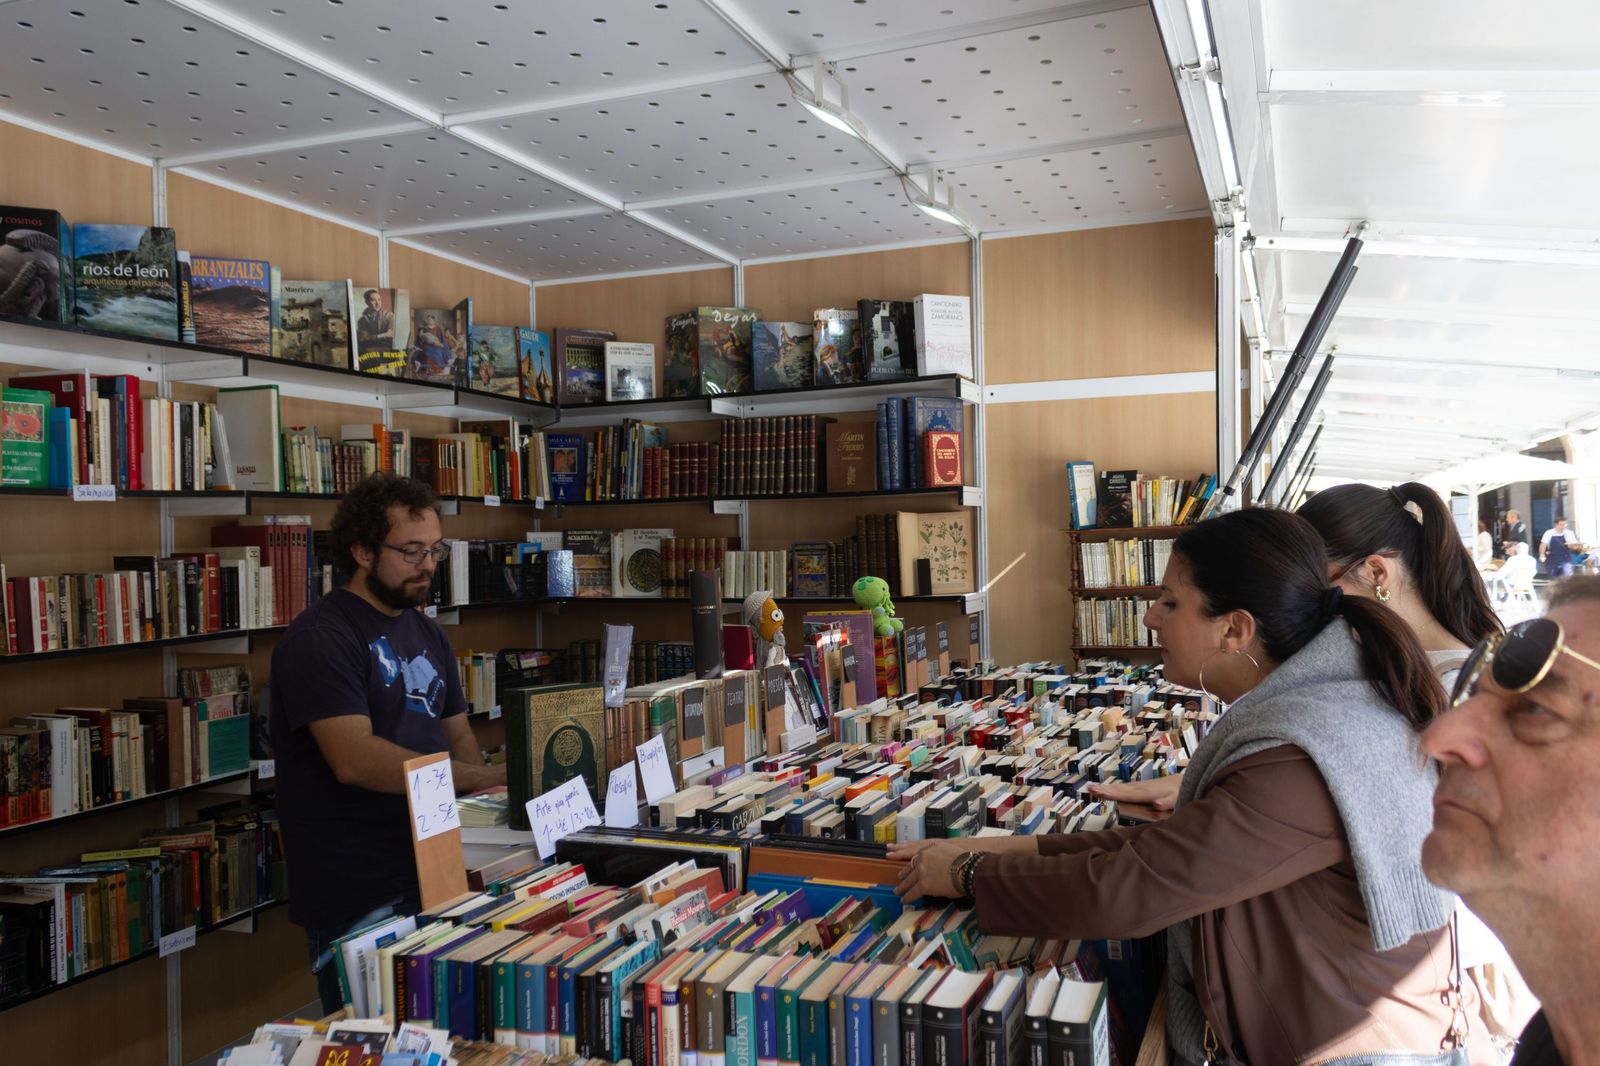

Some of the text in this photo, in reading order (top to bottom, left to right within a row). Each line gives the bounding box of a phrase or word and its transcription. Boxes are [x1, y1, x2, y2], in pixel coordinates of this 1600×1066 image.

[5, 215, 43, 227] cosmos
[82, 262, 169, 279] ríos de león
[84, 278, 128, 288] arquitectos
[128, 278, 141, 287] del
[711, 309, 759, 329] Degas
